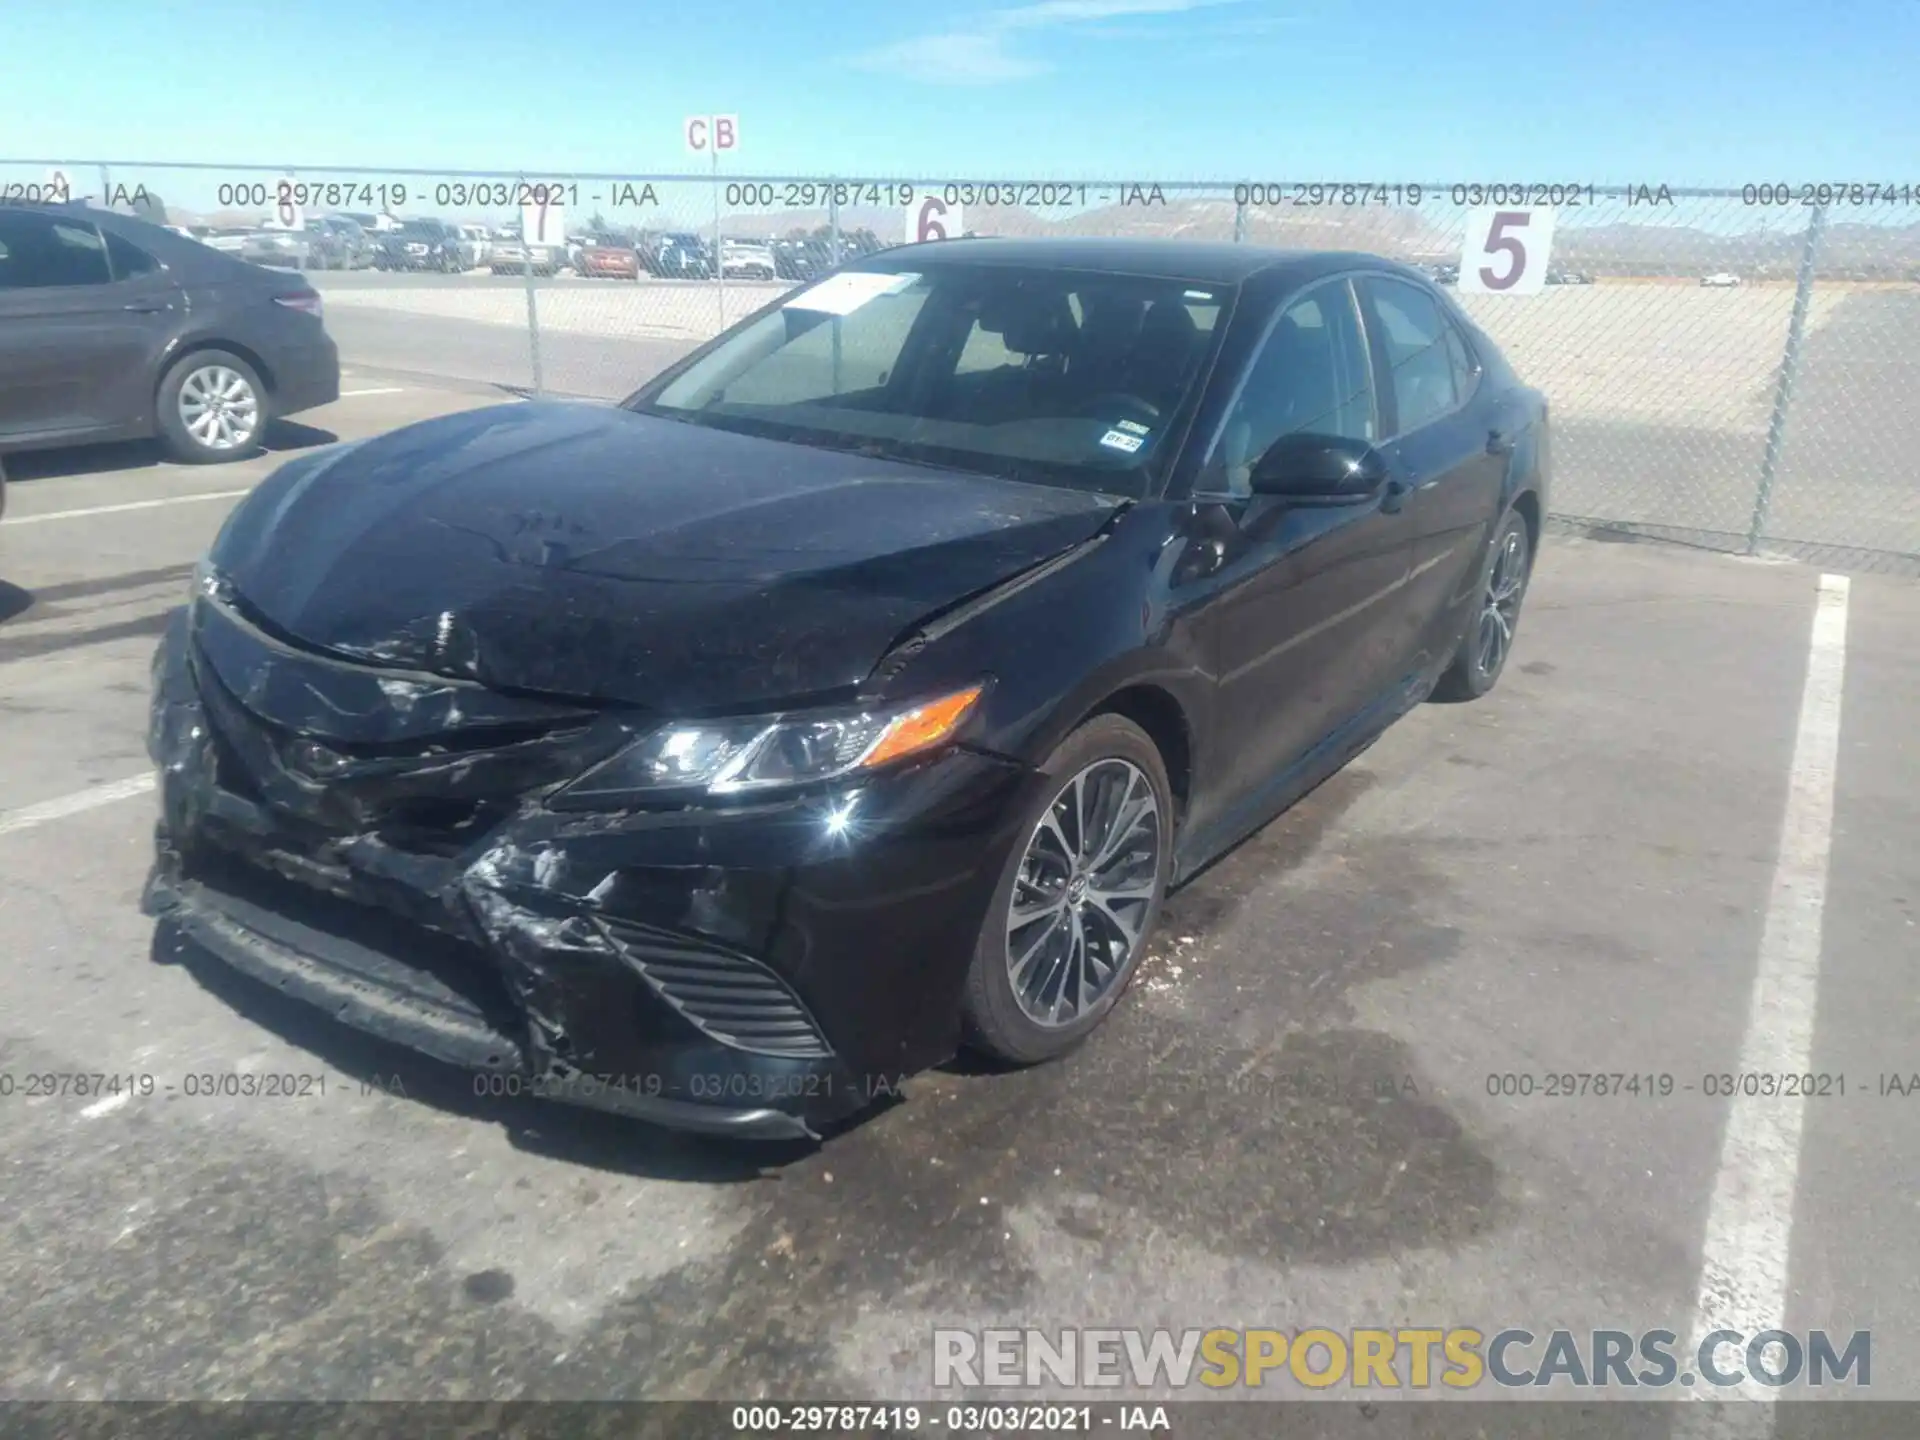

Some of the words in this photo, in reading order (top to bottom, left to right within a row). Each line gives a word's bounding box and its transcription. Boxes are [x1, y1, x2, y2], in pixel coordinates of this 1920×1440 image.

[689, 119, 706, 150] C
[716, 118, 735, 149] B
[918, 197, 947, 243] 6
[1479, 211, 1531, 291] 5
